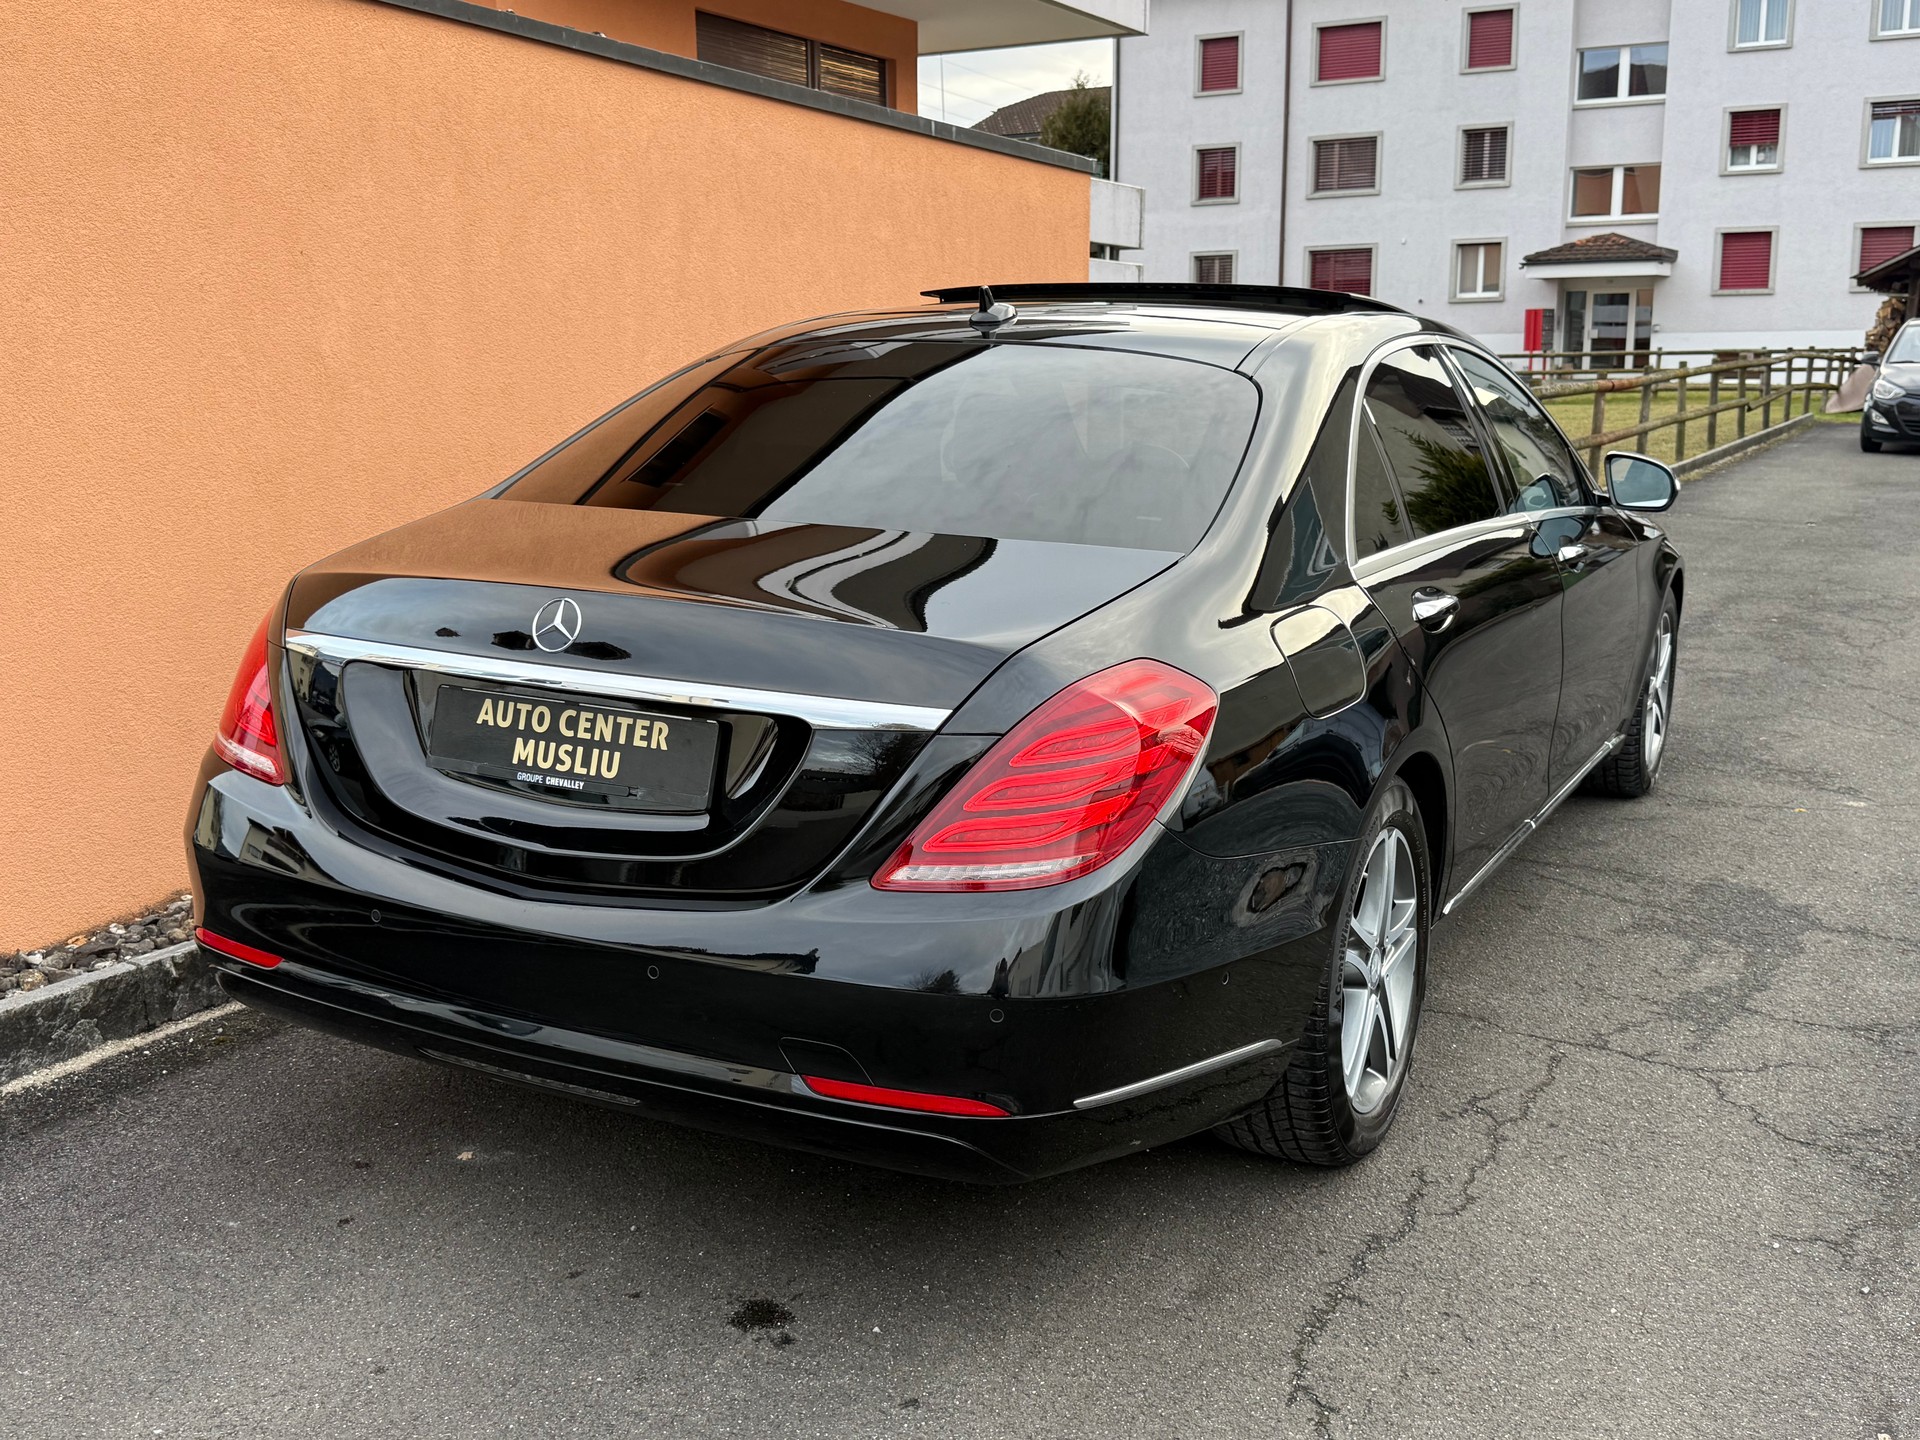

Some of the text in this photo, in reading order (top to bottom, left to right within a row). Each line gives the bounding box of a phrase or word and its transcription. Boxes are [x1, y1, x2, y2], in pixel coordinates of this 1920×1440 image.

[476, 698, 670, 751] AUTO CENTER
[511, 737, 621, 779] MUSLIU
[516, 771, 585, 790] GROUPE CHEVALLEY
